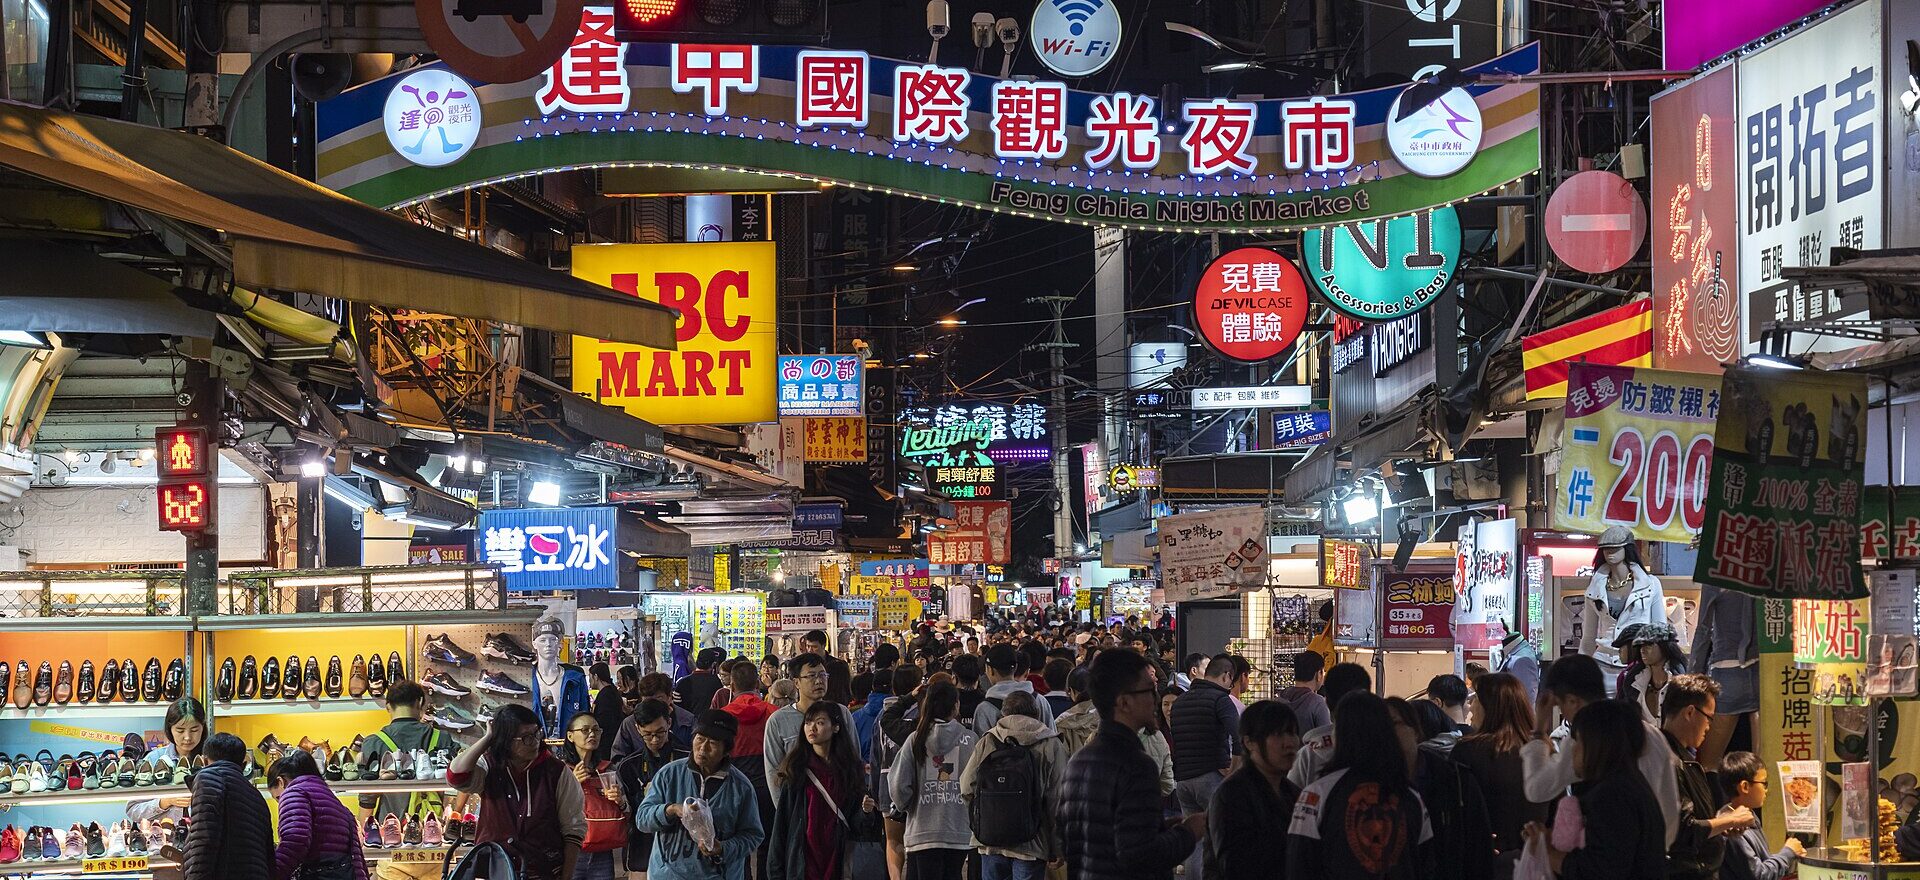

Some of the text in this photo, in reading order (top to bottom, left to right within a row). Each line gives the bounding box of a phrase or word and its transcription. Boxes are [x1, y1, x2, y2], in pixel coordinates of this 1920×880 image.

[1043, 37, 1111, 58] Wi-Fi
[538, 7, 1355, 175] 逢甲國際觀光夜市
[448, 112, 472, 125] 夜市
[1747, 66, 1876, 235] 開拓者
[990, 182, 1371, 224] Feng Chia Night Market
[1221, 262, 1282, 293] 免費
[1321, 270, 1448, 315] Accessories & Bags
[1221, 312, 1283, 343] 體驗
[598, 349, 751, 398] MART
[783, 357, 856, 381] 尚の都
[781, 382, 859, 400] 商品專賣
[1199, 392, 1209, 401] 3C
[1213, 391, 1233, 401] 配件
[1260, 390, 1280, 400] 維修
[1569, 375, 1619, 412] 免燙
[1275, 412, 1317, 439] 男裝
[1293, 437, 1307, 447] BIG
[1307, 432, 1325, 443] SIZE
[936, 467, 996, 482] 肩頸舒壓
[1603, 427, 1714, 535] 200
[1723, 462, 1748, 509] 逢甲
[1752, 477, 1858, 517] 100% 全素
[957, 505, 985, 527] 按摩
[442, 550, 464, 560] SALE
[930, 541, 985, 563] 肩頸舒壓
[1709, 510, 1860, 595] 鹽酥菇
[875, 563, 916, 576] 工廠直營
[782, 616, 796, 625] 250
[797, 616, 811, 625] 375
[812, 616, 826, 624] 500
[1389, 624, 1436, 635] 每份60元
[1764, 599, 1786, 644] 逢甲
[1781, 665, 1812, 760] 招牌菇
[920, 793, 936, 805] NOT
[924, 781, 950, 792] SPIRIT
